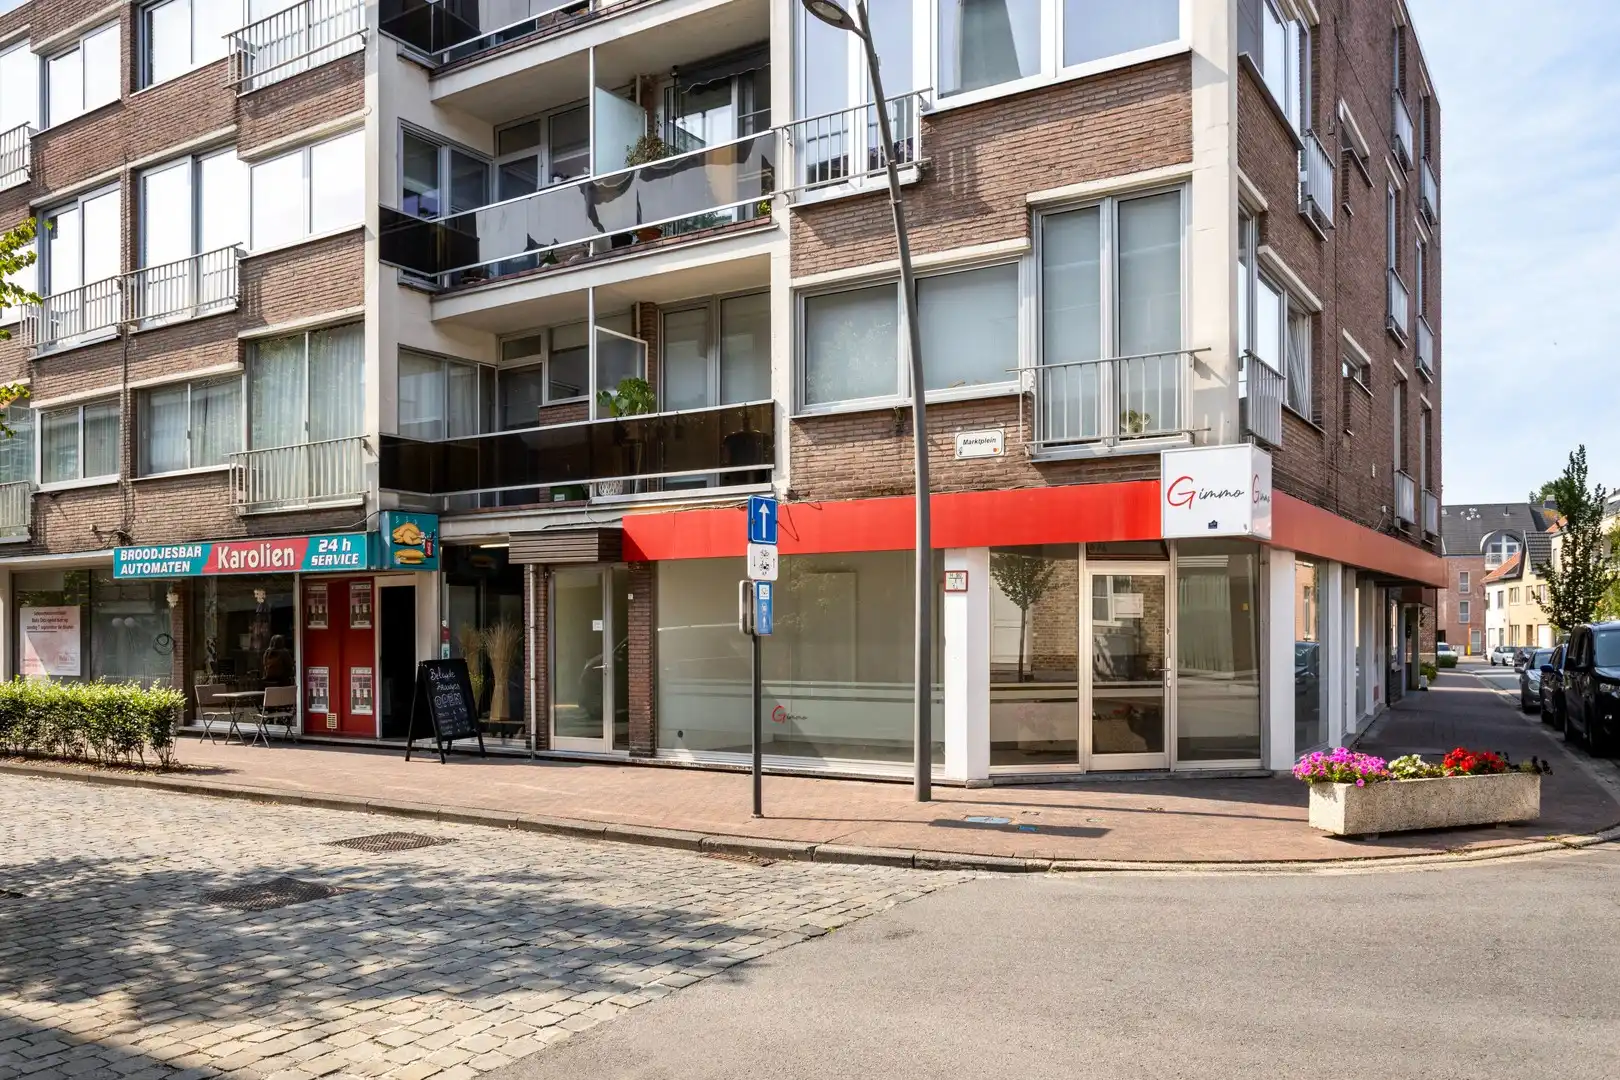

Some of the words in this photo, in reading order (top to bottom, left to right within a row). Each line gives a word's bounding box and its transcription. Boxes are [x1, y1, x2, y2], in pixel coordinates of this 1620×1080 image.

[962, 437, 997, 446] Marktplein
[318, 539, 338, 553] 24
[342, 538, 351, 551] h
[120, 546, 202, 561] BROODJESBAR
[216, 543, 295, 570] Karolien
[310, 553, 359, 567] SERVICE
[120, 561, 191, 575] AUTOMATEN
[435, 693, 462, 708] OPEN
